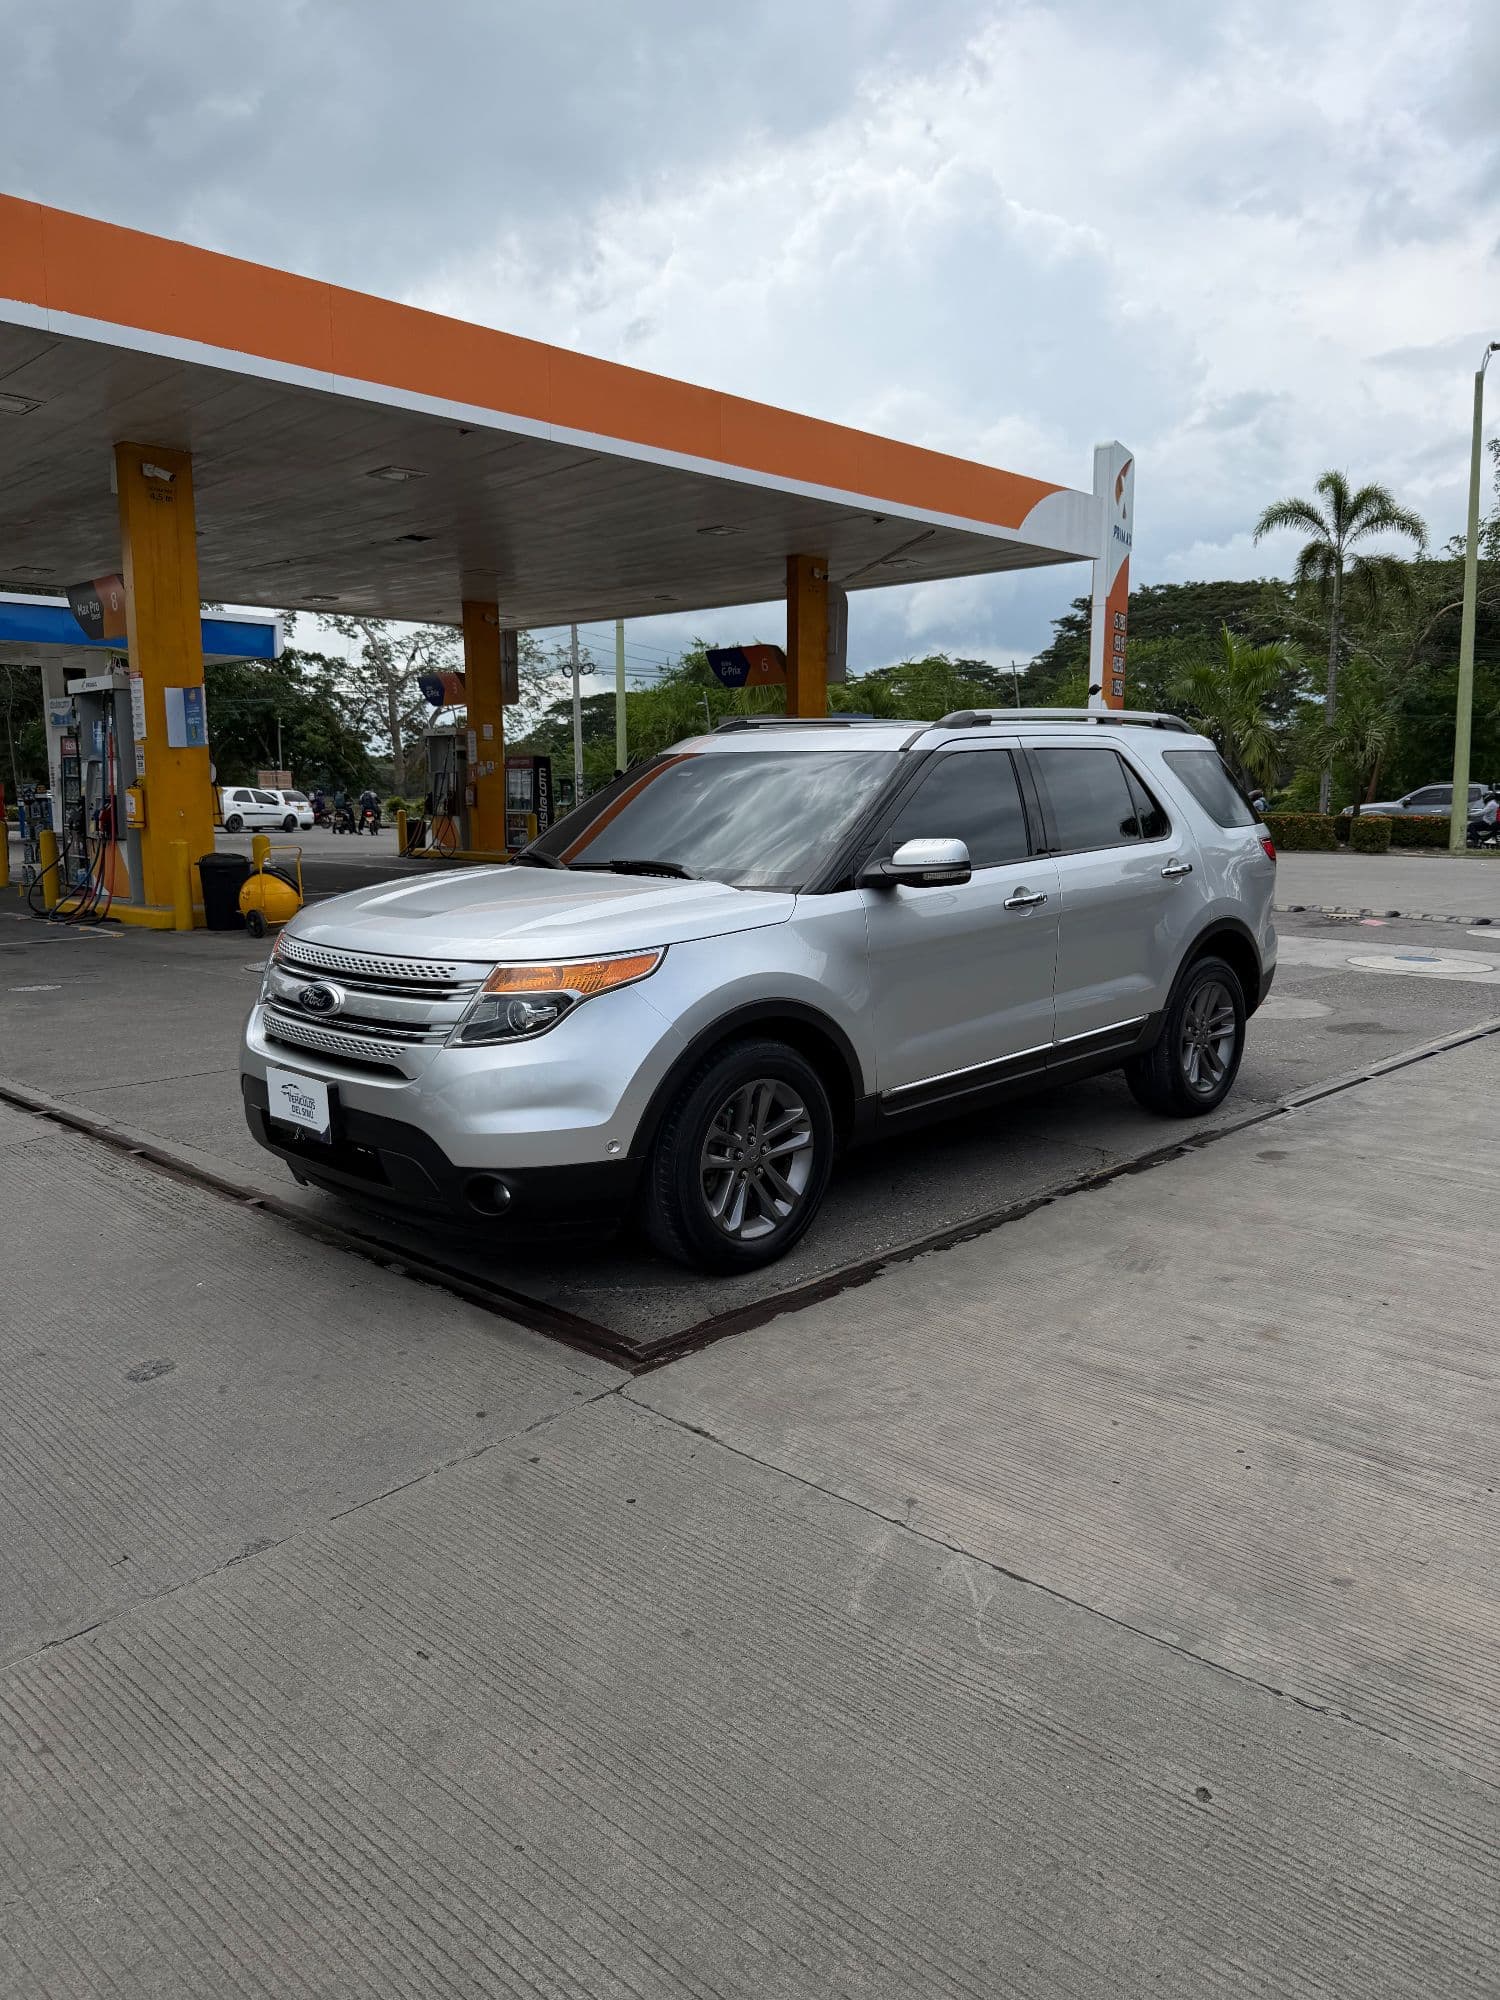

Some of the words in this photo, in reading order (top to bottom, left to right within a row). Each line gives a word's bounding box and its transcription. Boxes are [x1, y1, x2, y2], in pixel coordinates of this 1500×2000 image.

[1112, 525, 1132, 547] PRIMAX
[77, 603, 90, 617] Max
[89, 601, 100, 613] Pro
[111, 592, 118, 612] 8
[721, 665, 742, 677] G-Prix
[761, 658, 769, 672] 6
[303, 987, 326, 1007] Ford
[291, 1104, 301, 1115] DEL
